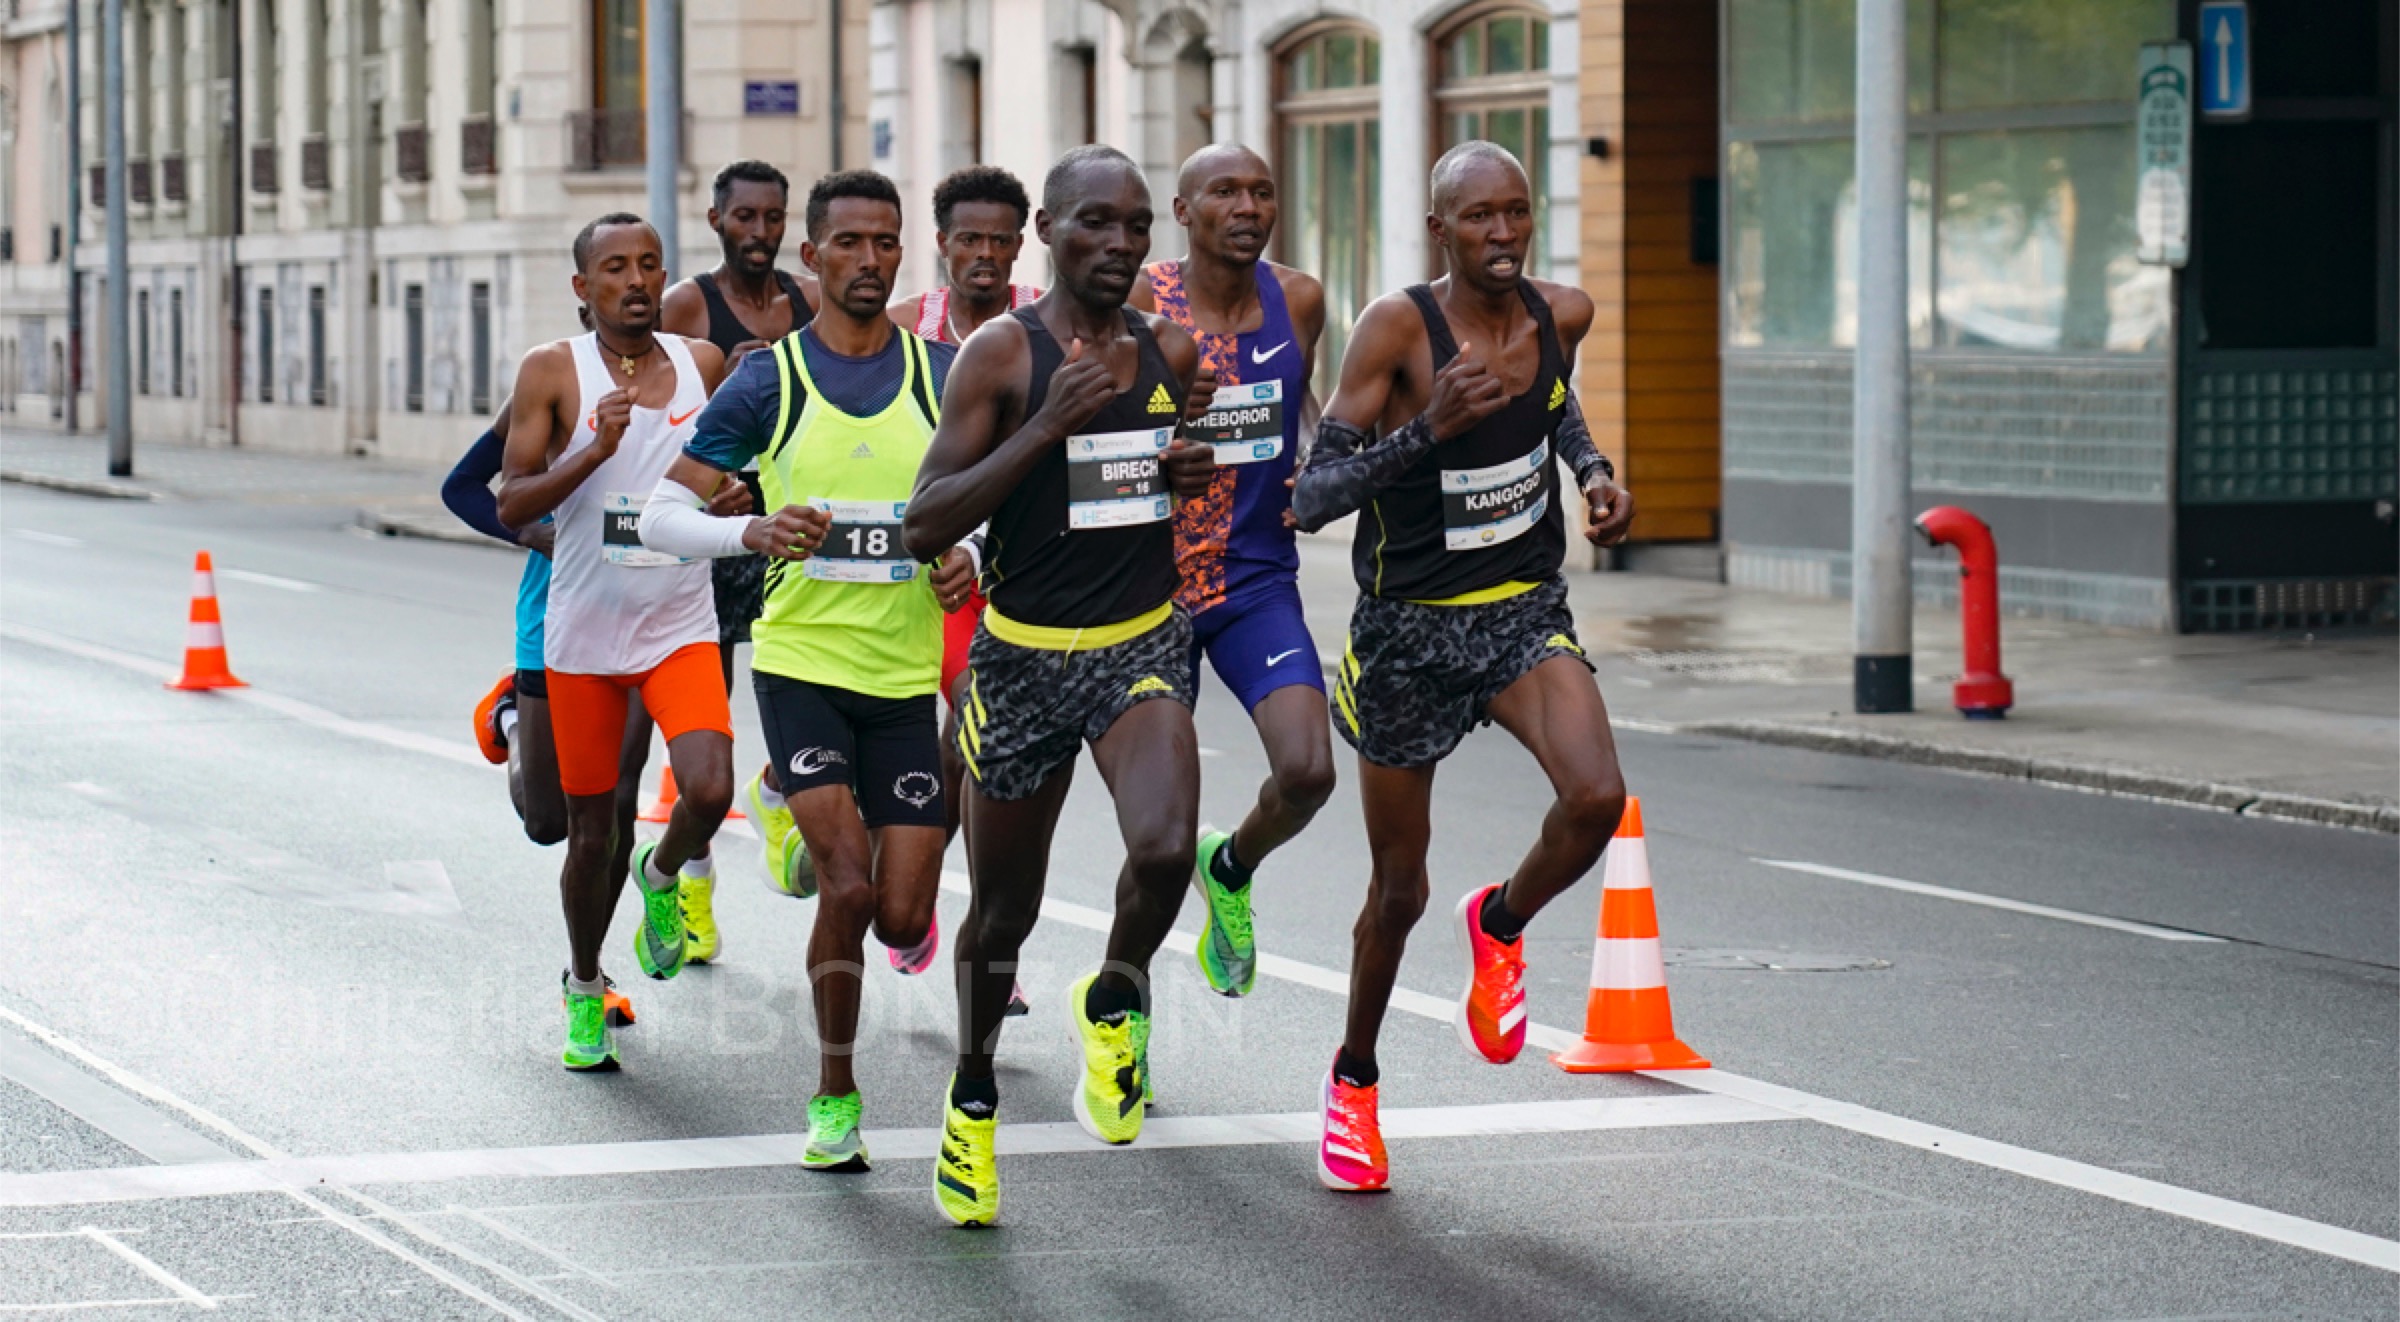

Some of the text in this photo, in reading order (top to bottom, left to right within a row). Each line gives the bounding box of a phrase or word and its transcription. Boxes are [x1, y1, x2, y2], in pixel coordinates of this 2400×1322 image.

[1101, 459, 1159, 482] BIRECH
[1136, 481, 1151, 495] 16
[1465, 472, 1541, 511] KANGOGO
[1511, 499, 1525, 513] 17
[845, 527, 889, 557] 18
